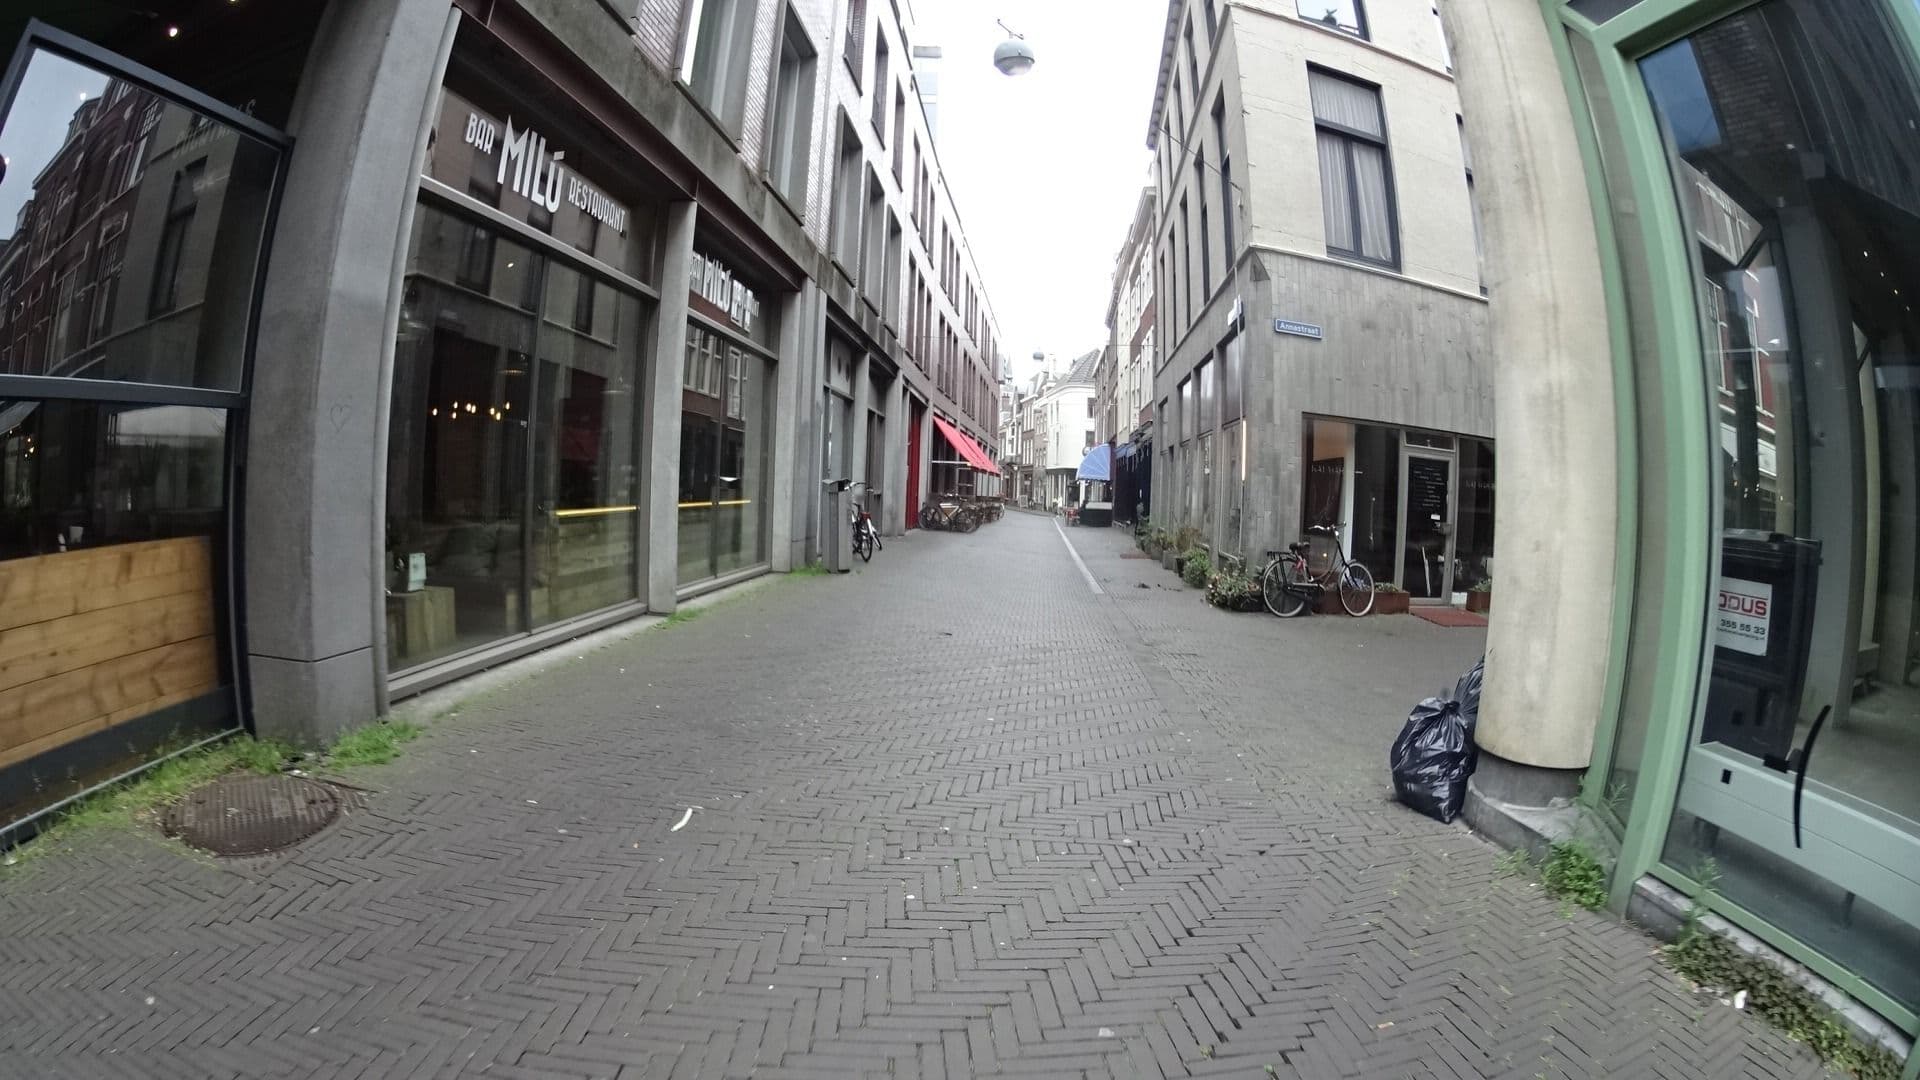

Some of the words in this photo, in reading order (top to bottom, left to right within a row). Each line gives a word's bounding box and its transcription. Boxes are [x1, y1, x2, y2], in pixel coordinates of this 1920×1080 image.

[465, 112, 496, 155] BAR
[497, 114, 565, 213] MILÚ
[568, 176, 626, 233] RESTAURANT
[1279, 321, 1319, 335] Annastraat
[1720, 618, 1737, 629] 355
[1739, 623, 1751, 632] 55
[1753, 626, 1766, 635] 33
